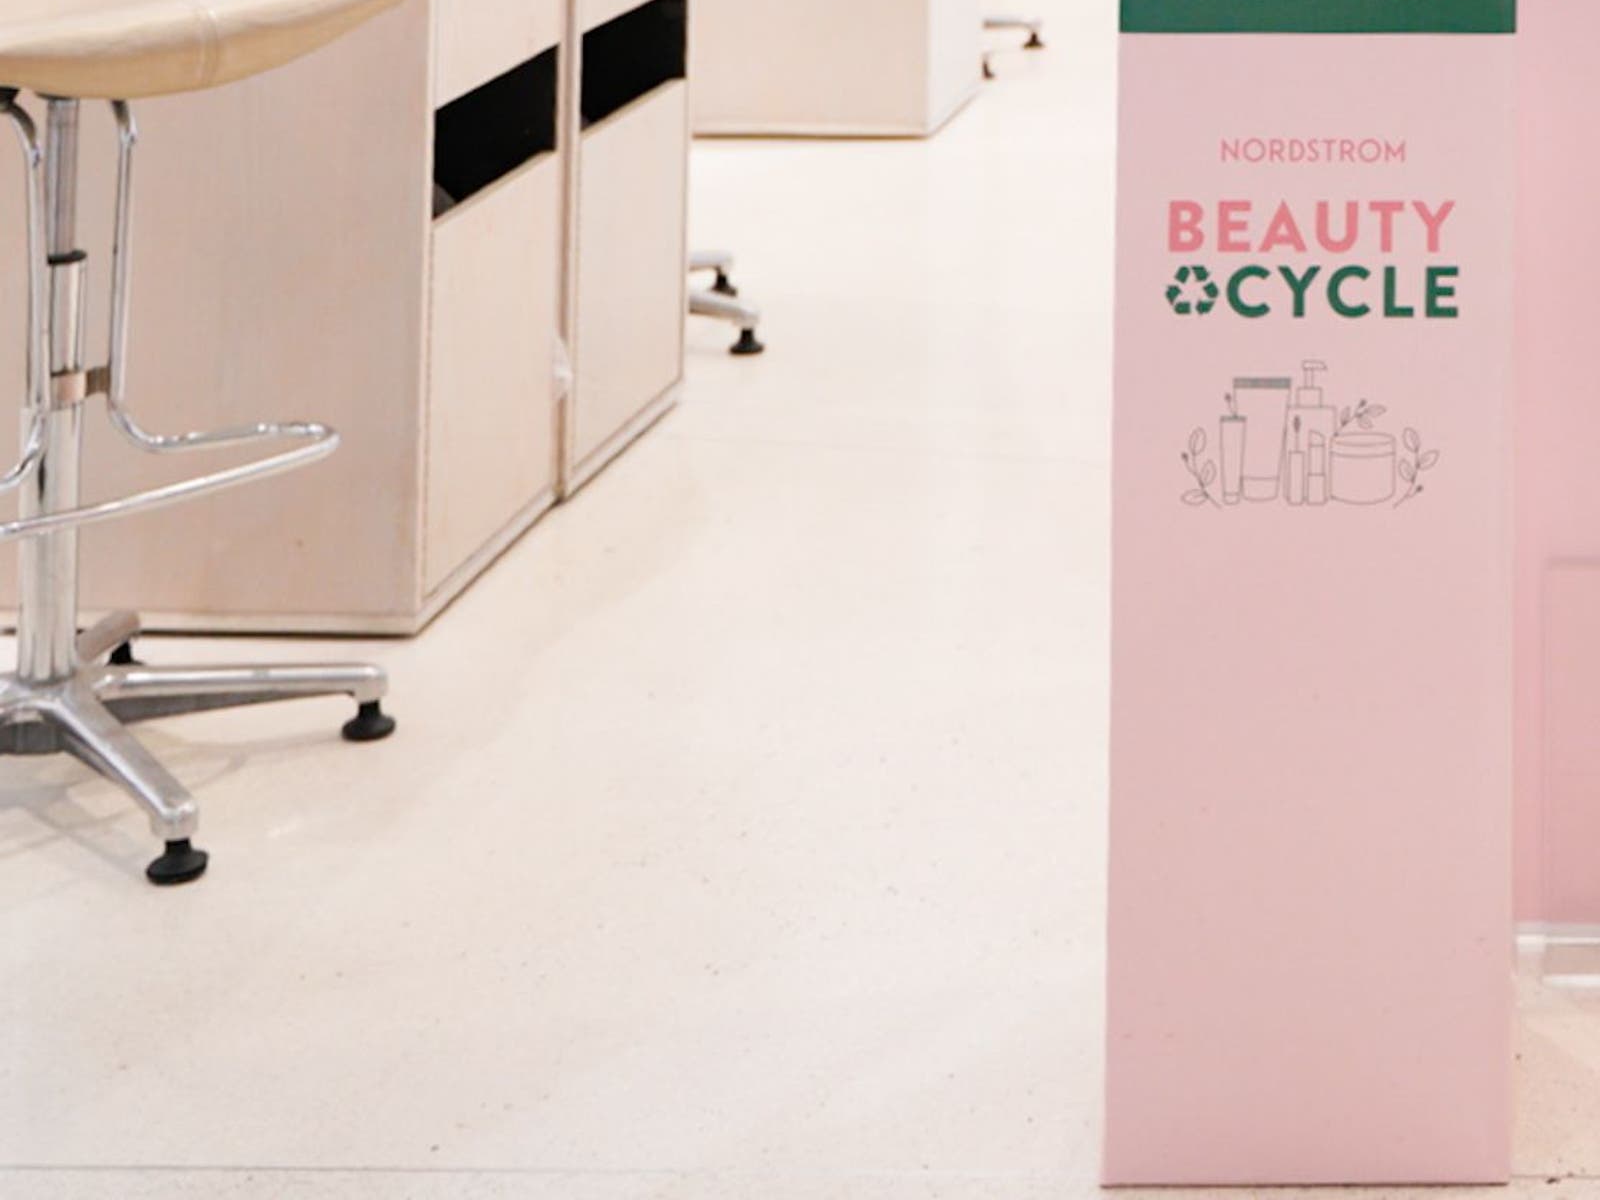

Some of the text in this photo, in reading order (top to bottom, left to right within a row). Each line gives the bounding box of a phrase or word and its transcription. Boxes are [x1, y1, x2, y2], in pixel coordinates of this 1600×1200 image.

[1221, 138, 1406, 163] NORDSTROM
[1168, 200, 1455, 253] BEAUTY
[1226, 265, 1459, 318] CYCLE
